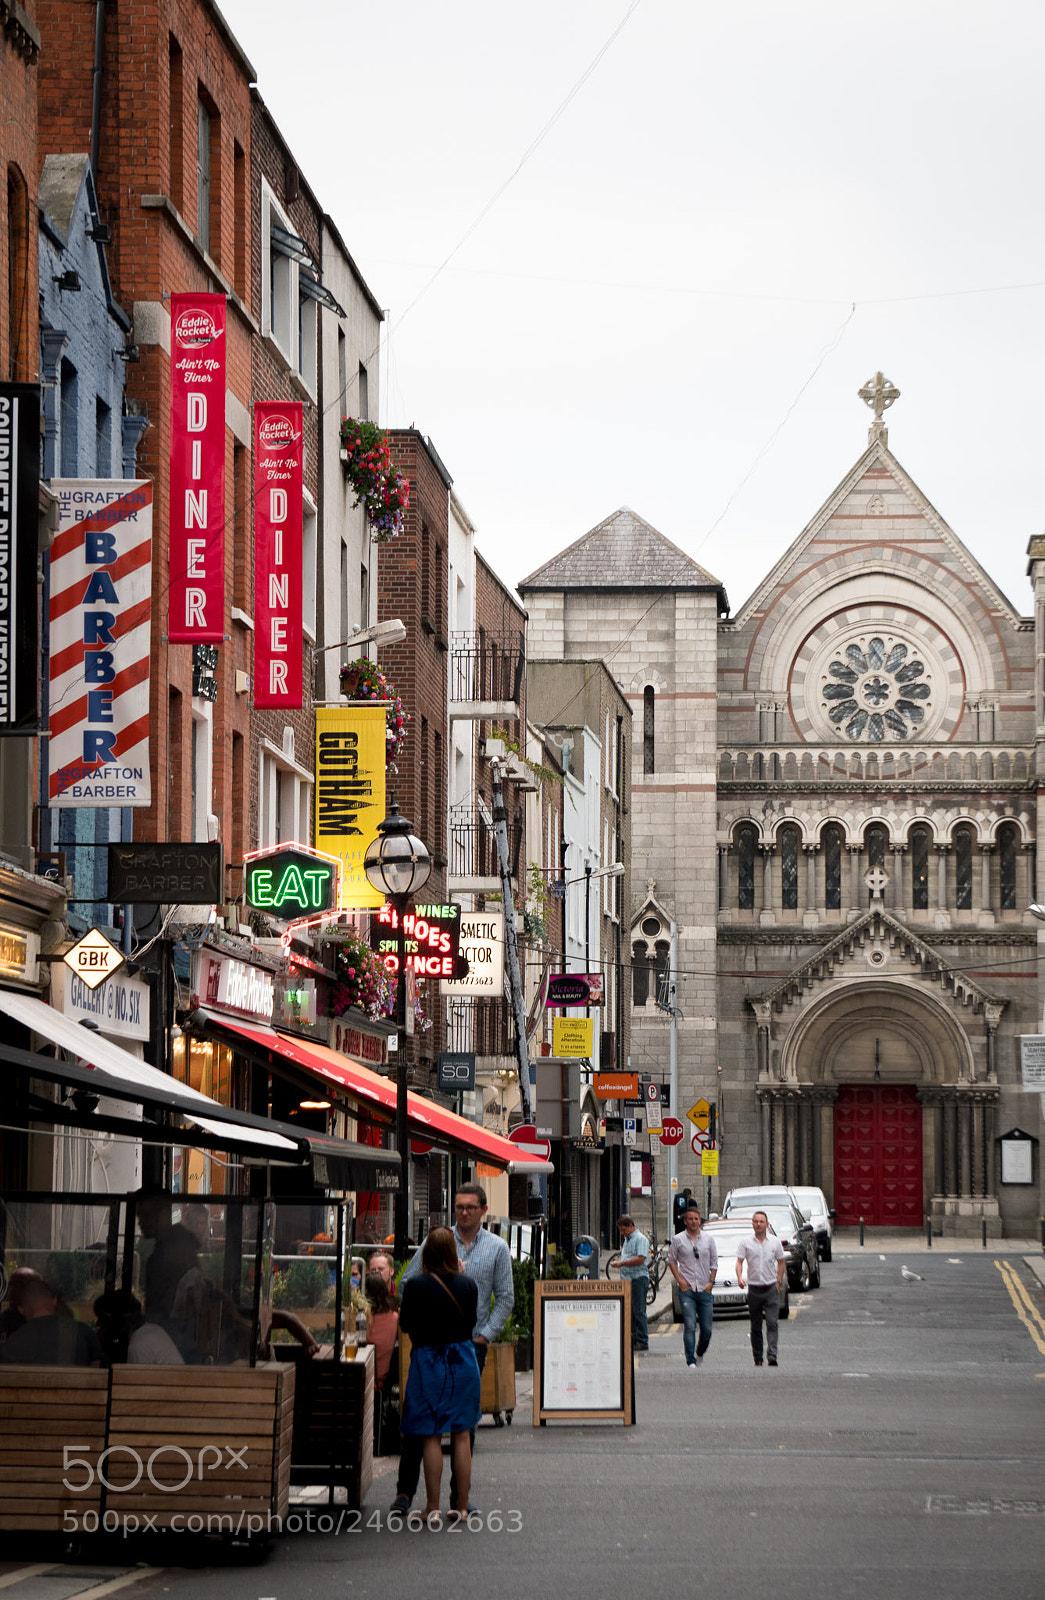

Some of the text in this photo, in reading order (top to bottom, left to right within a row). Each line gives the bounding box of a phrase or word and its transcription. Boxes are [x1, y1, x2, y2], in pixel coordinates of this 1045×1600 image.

[181, 316, 210, 328] Eddie
[176, 324, 216, 337] Rocket's
[175, 358, 220, 371] Ain't No
[264, 421, 289, 432] Eddie
[259, 458, 298, 469] Ain't No
[73, 491, 146, 504] GRAFTON
[59, 491, 71, 521] THE
[185, 392, 208, 627] DINER
[75, 510, 138, 522] BARBER
[268, 489, 289, 695] DINER
[82, 532, 120, 763] BARBER
[70, 767, 143, 779] GRAFTON
[57, 768, 69, 797] THE
[319, 732, 373, 836] GOTHAM
[72, 785, 136, 797] BARBER
[120, 854, 213, 869] GRAFTON
[125, 875, 205, 890] BARBER
[252, 865, 330, 908] EAT
[415, 904, 457, 918] WINES
[460, 922, 497, 940] SMETIC
[78, 951, 109, 967] GBK
[551, 984, 584, 994] Victoria
[129, 990, 141, 1025] SIX
[442, 1065, 470, 1079] SO
[661, 1127, 683, 1137] TOP
[543, 1282, 623, 1292] GOURMET BURGER KITCHEN
[573, 1303, 592, 1311] BURGER
[594, 1303, 616, 1311] KITCHEN
